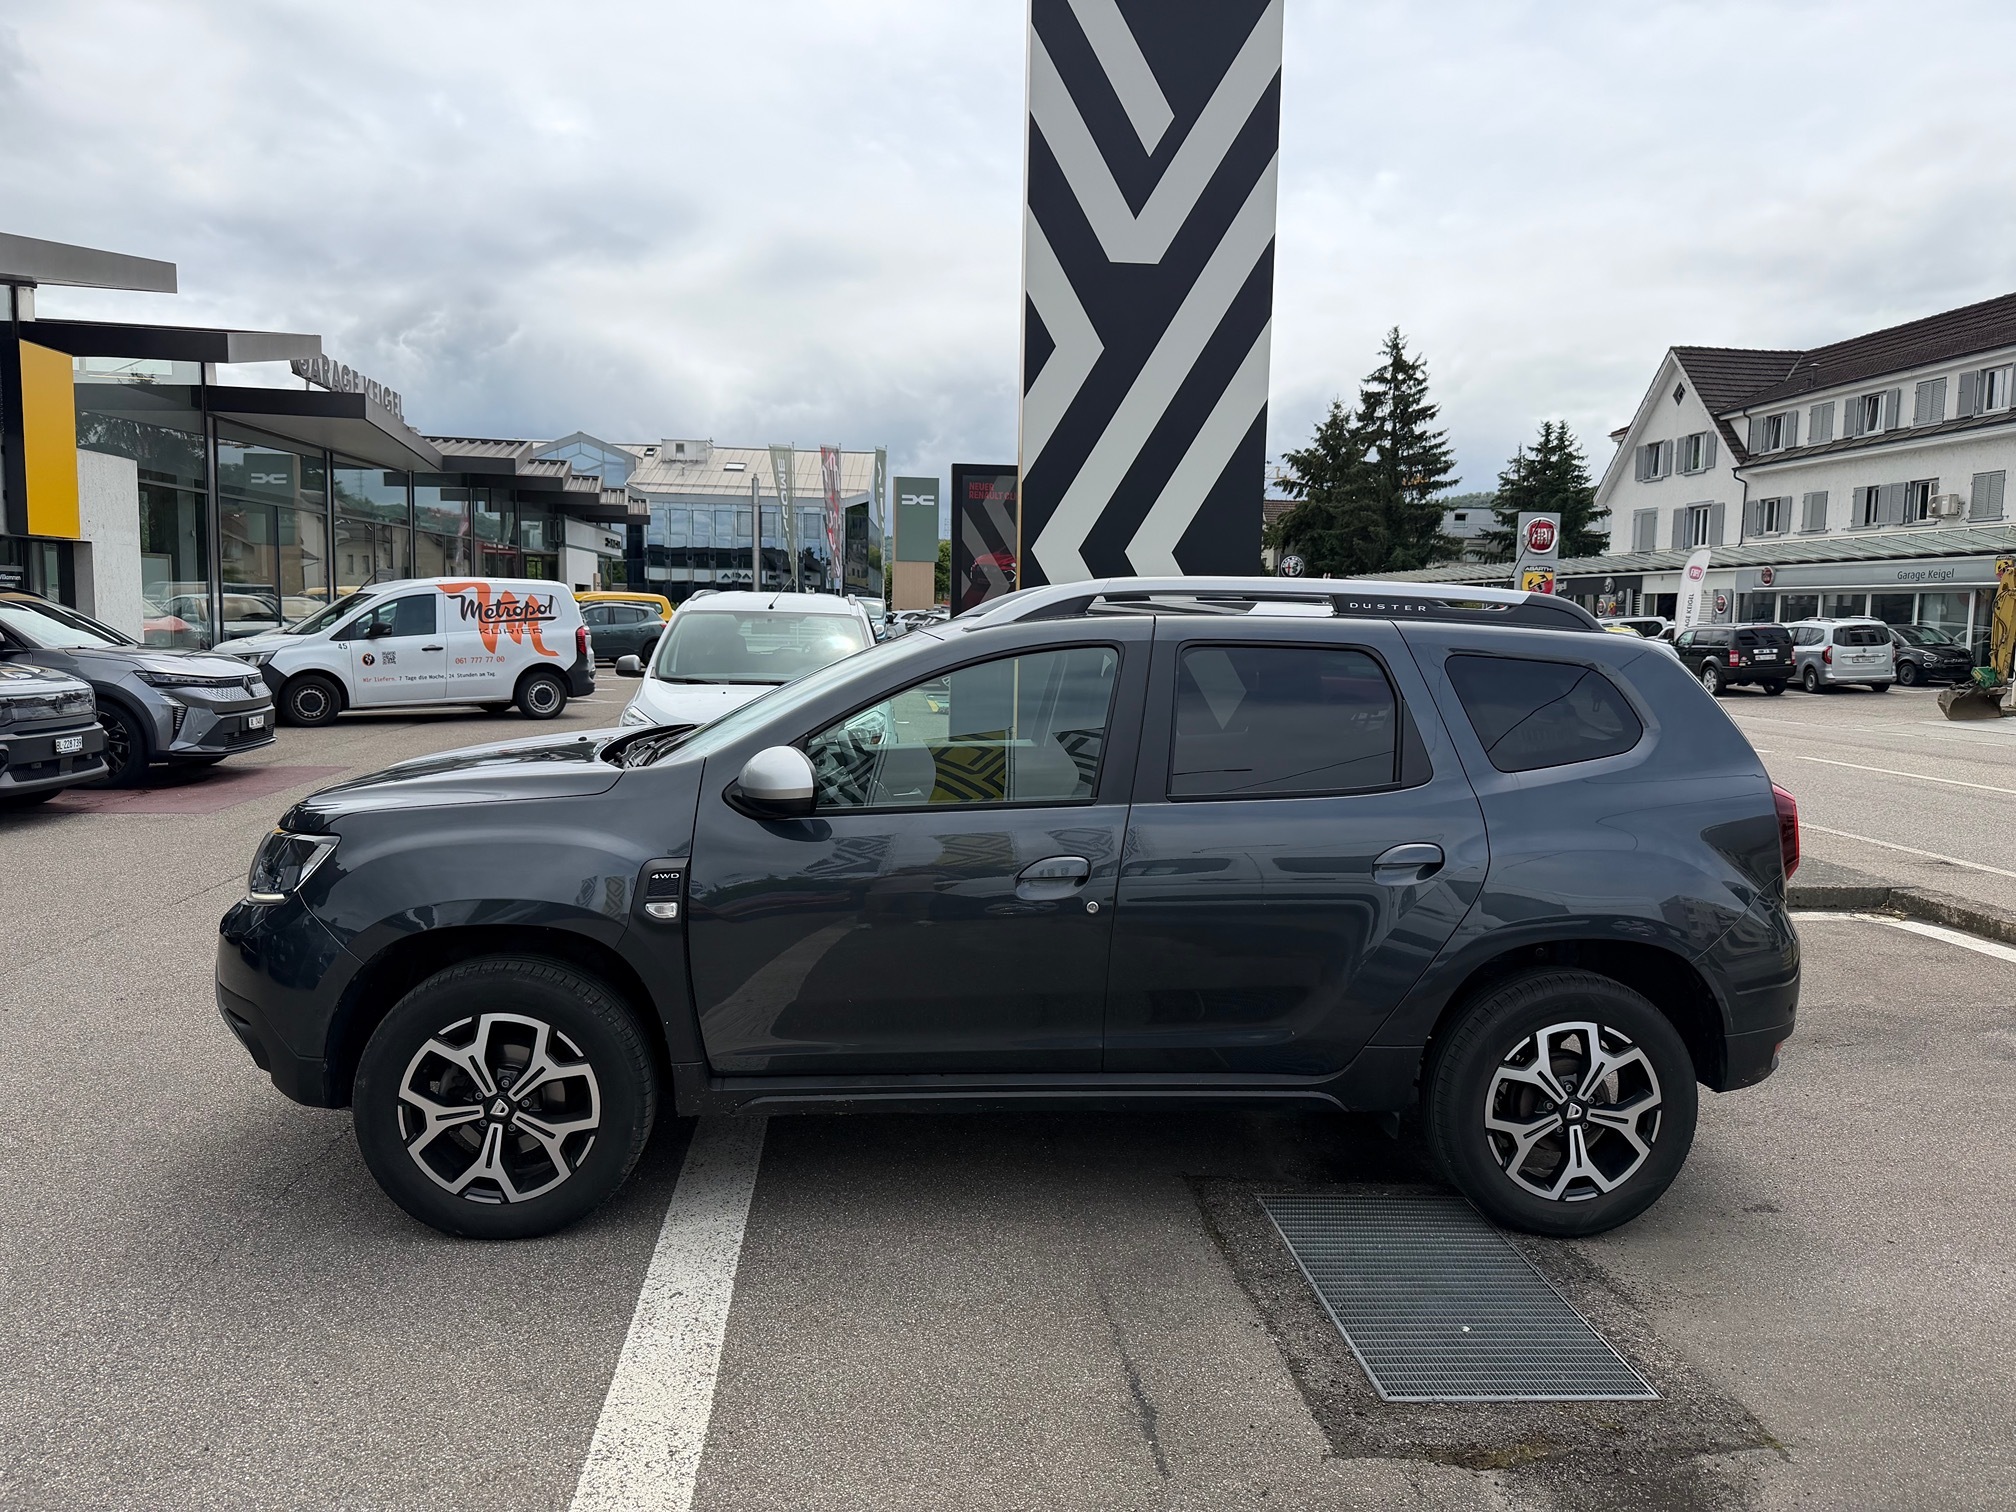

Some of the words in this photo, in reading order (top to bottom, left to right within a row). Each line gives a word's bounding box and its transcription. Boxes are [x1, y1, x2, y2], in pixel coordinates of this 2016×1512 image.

[297, 354, 359, 393] GARAGE
[969, 481, 995, 491] NEUER
[969, 491, 1002, 500] RENAULT
[1532, 528, 1553, 545] FIAT
[1897, 571, 1926, 581] Garage
[1928, 568, 1955, 581] Keigel
[446, 594, 556, 624] Metropol
[1349, 602, 1426, 612] DUSTER
